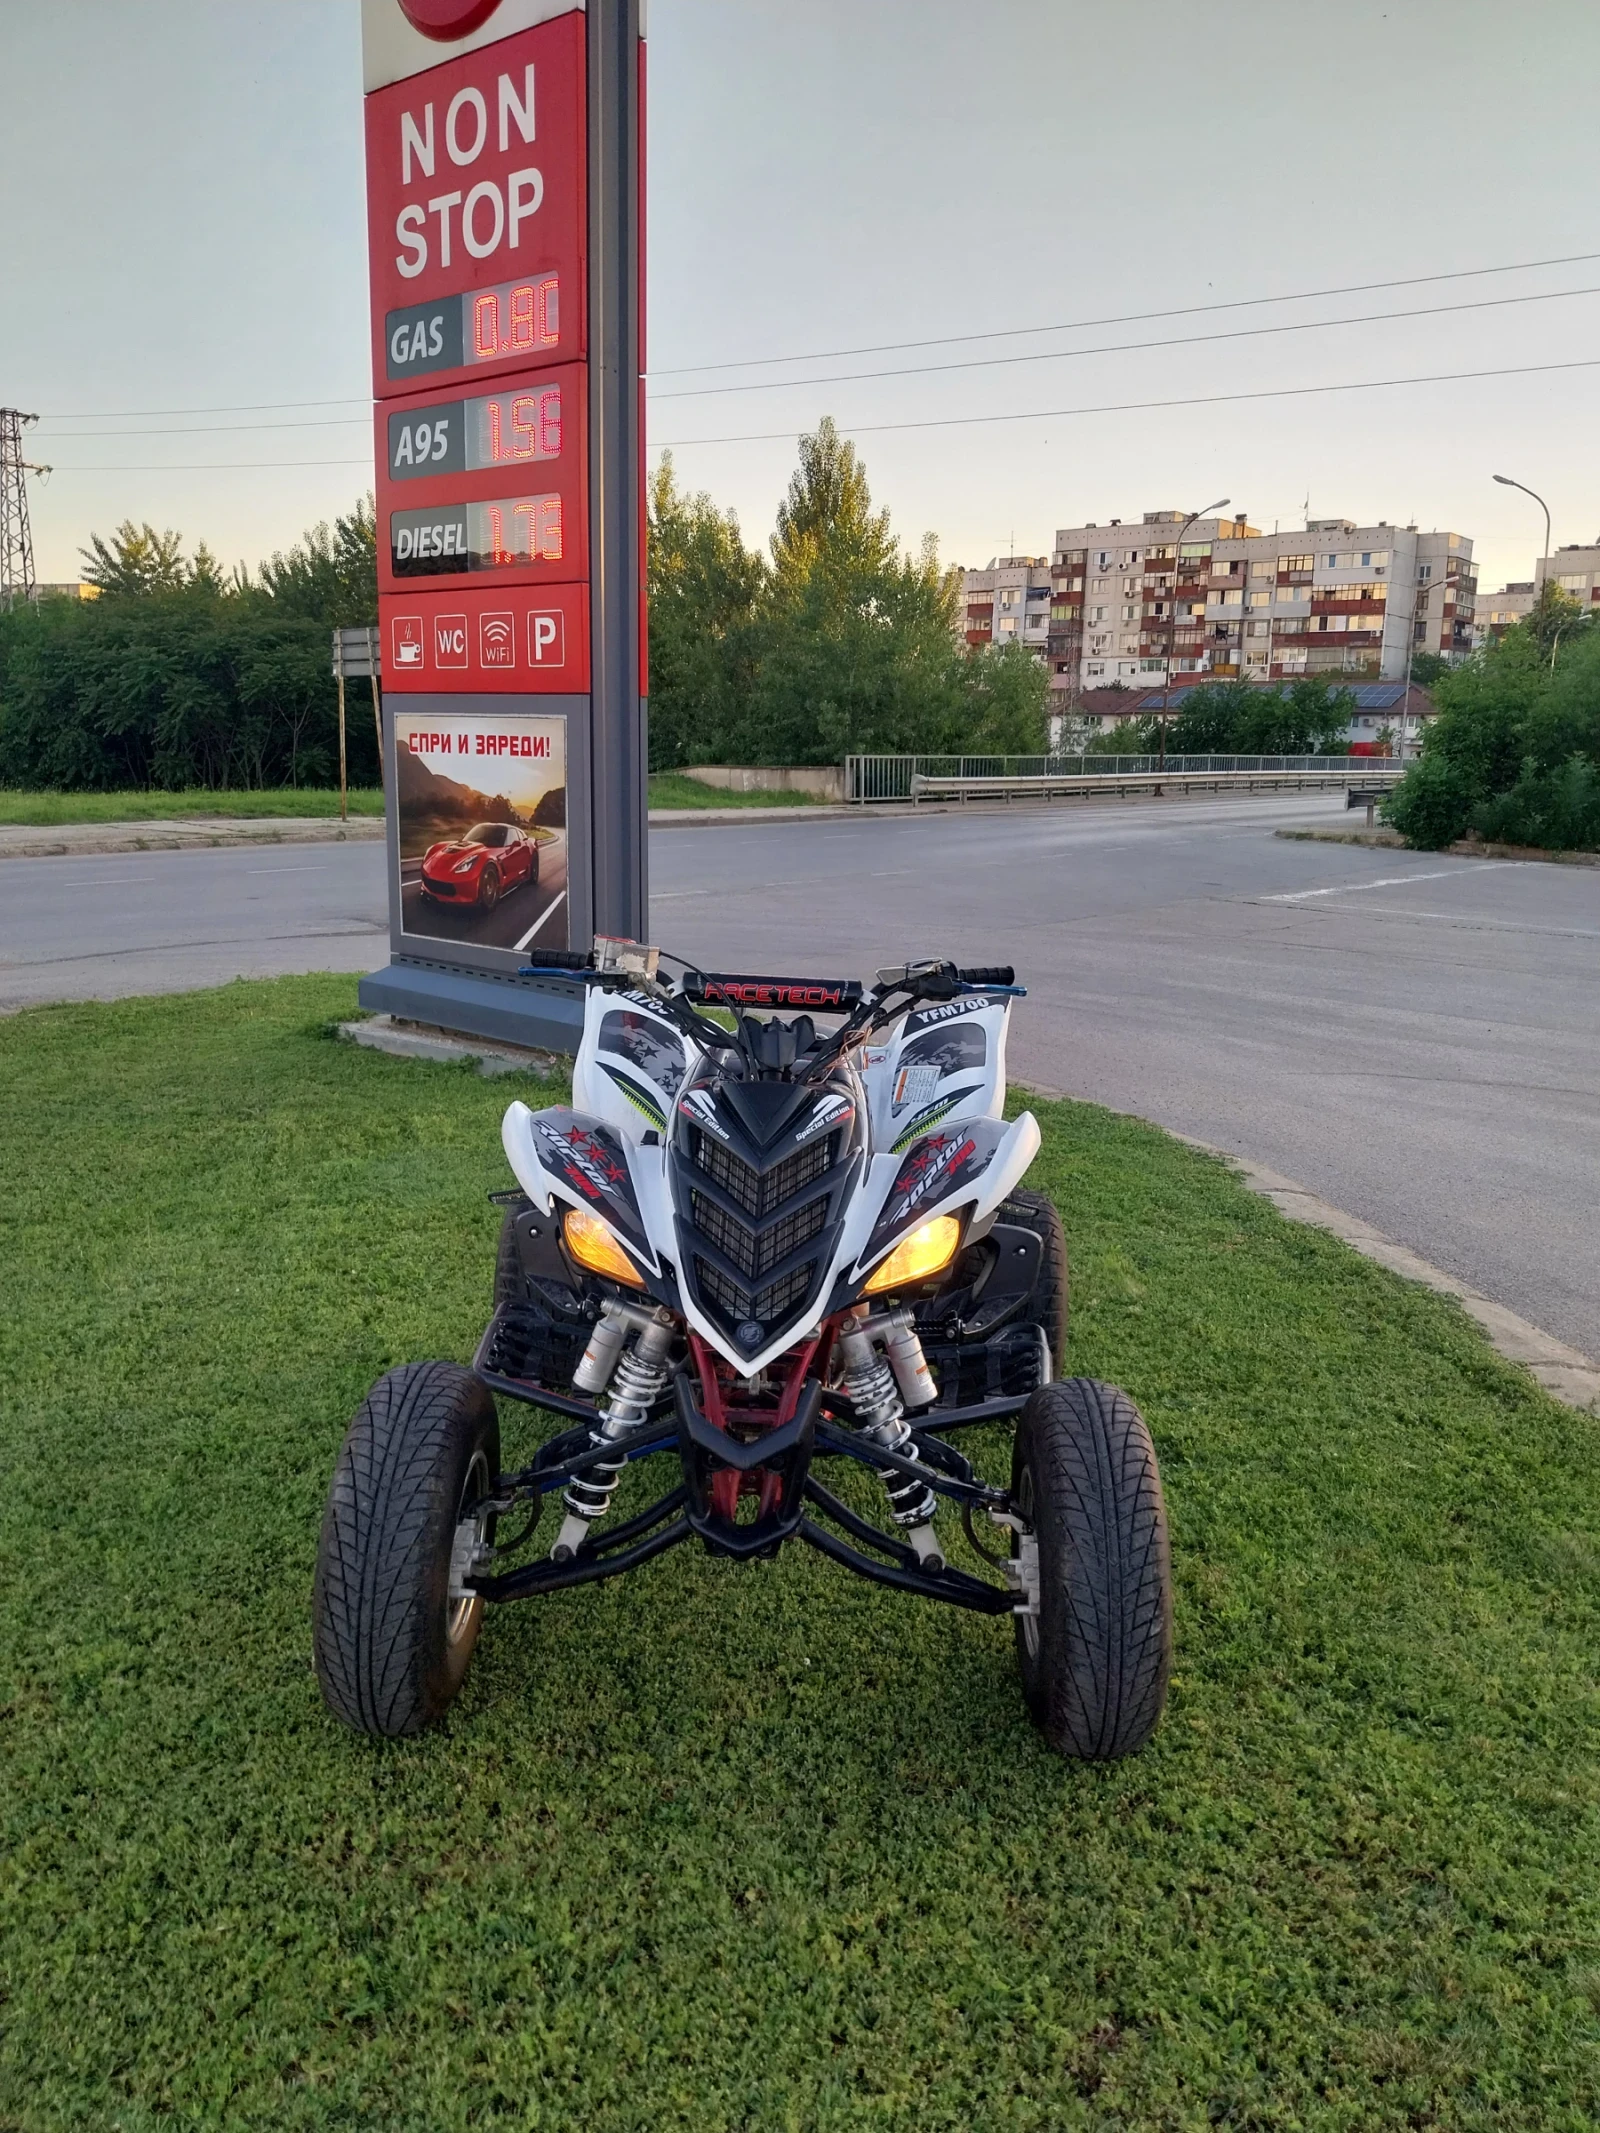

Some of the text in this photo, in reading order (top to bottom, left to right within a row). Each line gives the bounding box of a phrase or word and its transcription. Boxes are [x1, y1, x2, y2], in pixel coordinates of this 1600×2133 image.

[401, 63, 536, 185] NON
[395, 167, 544, 279] STOP
[390, 316, 443, 364] GAS
[394, 419, 449, 468] A95
[396, 523, 467, 560] DIESEL
[489, 501, 563, 565] 1.73
[437, 629, 465, 654] WC
[485, 646, 510, 662] WiFi
[534, 617, 557, 660] P
[408, 732, 551, 758] СПРИ И ЗАРЕДИ!
[704, 982, 841, 1005] RACETECH
[915, 998, 990, 1023] YFM700
[682, 1100, 730, 1140] Special Edition
[795, 1105, 850, 1142] Special Edition
